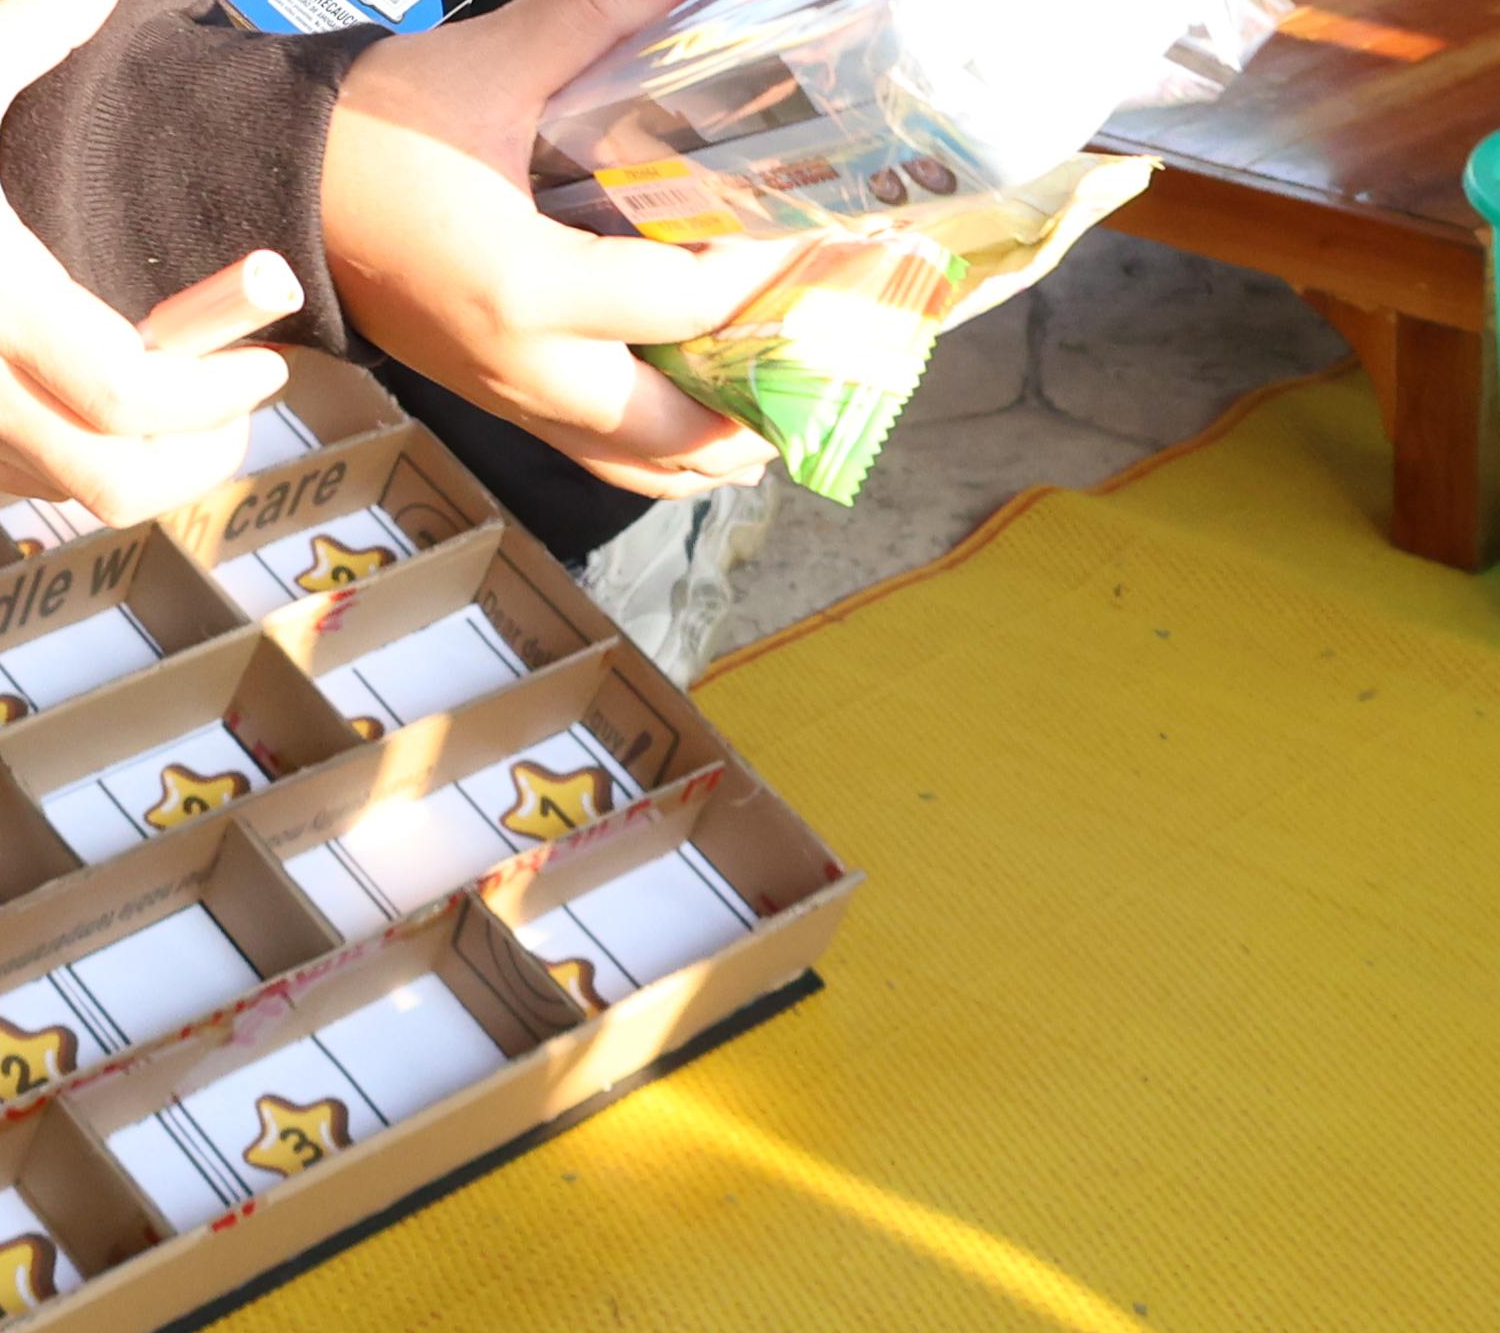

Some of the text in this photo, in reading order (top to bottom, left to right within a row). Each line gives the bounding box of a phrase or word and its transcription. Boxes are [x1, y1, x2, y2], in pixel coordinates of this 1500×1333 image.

[222, 460, 348, 542] care
[1, 1054, 49, 1096] 2
[279, 1127, 324, 1170] 3
